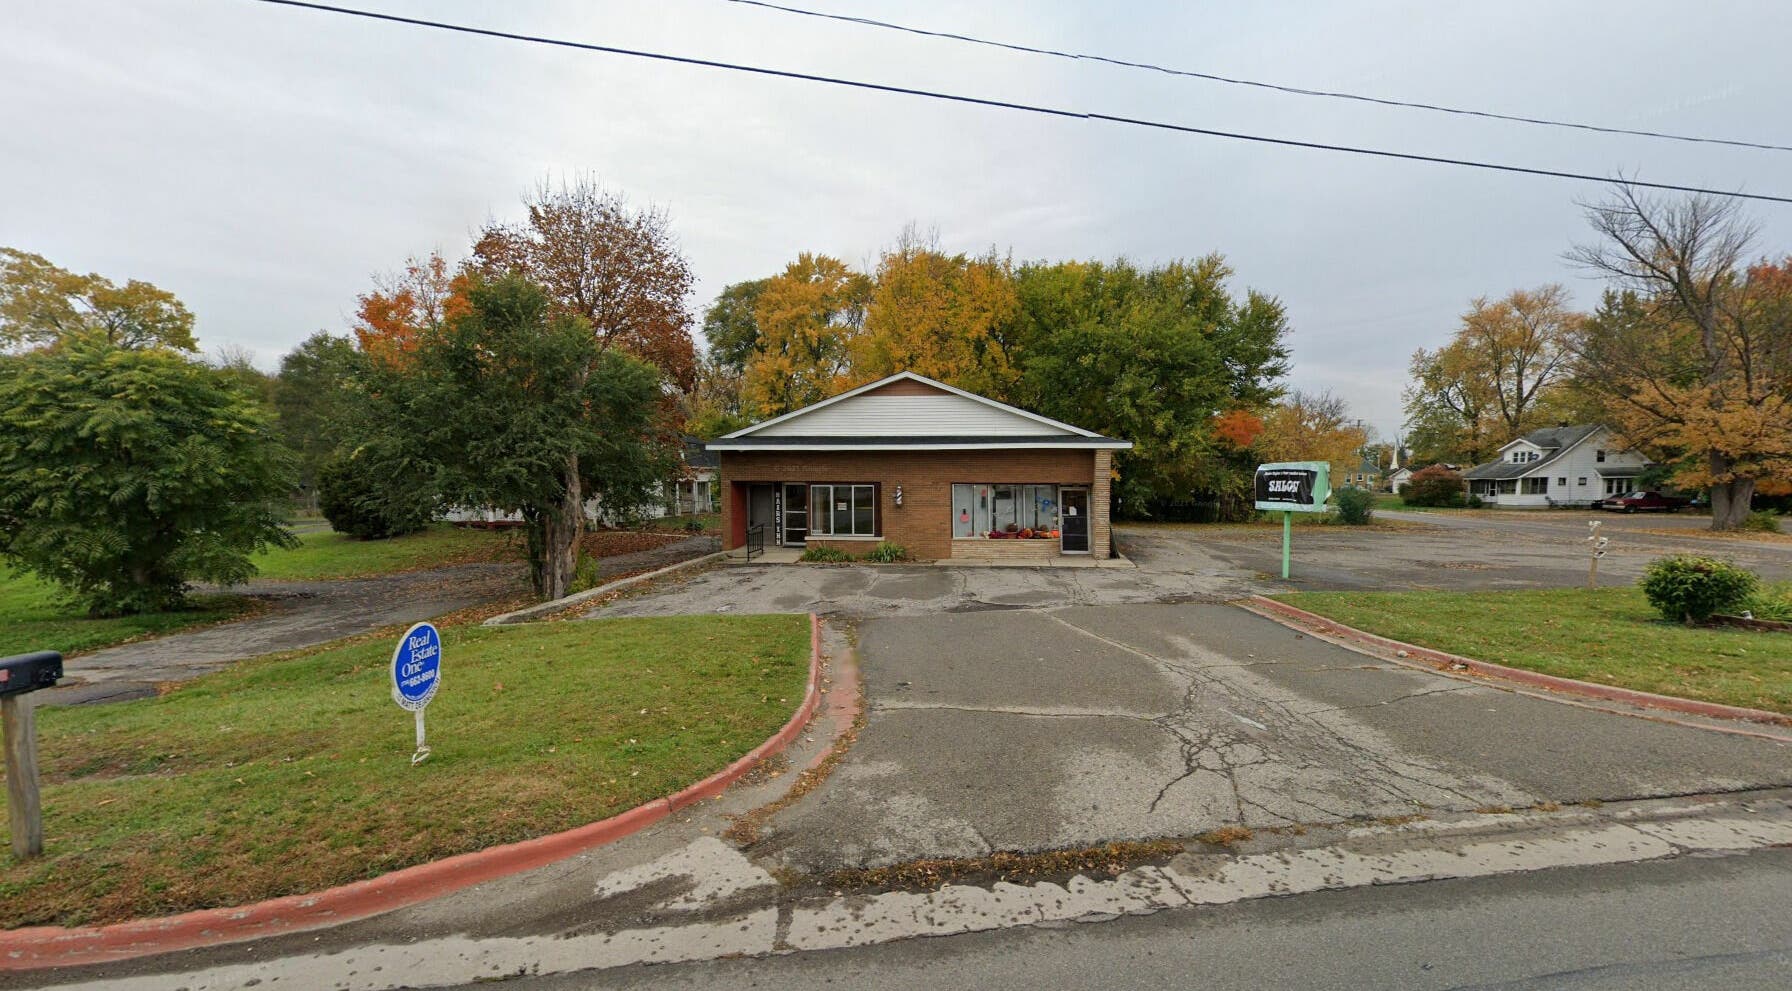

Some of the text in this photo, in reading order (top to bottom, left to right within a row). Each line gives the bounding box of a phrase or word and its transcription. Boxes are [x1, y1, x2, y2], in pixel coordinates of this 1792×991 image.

[1268, 480, 1300, 493] SALON
[408, 630, 431, 651] Real
[411, 644, 438, 663] Estate
[401, 661, 423, 677] One
